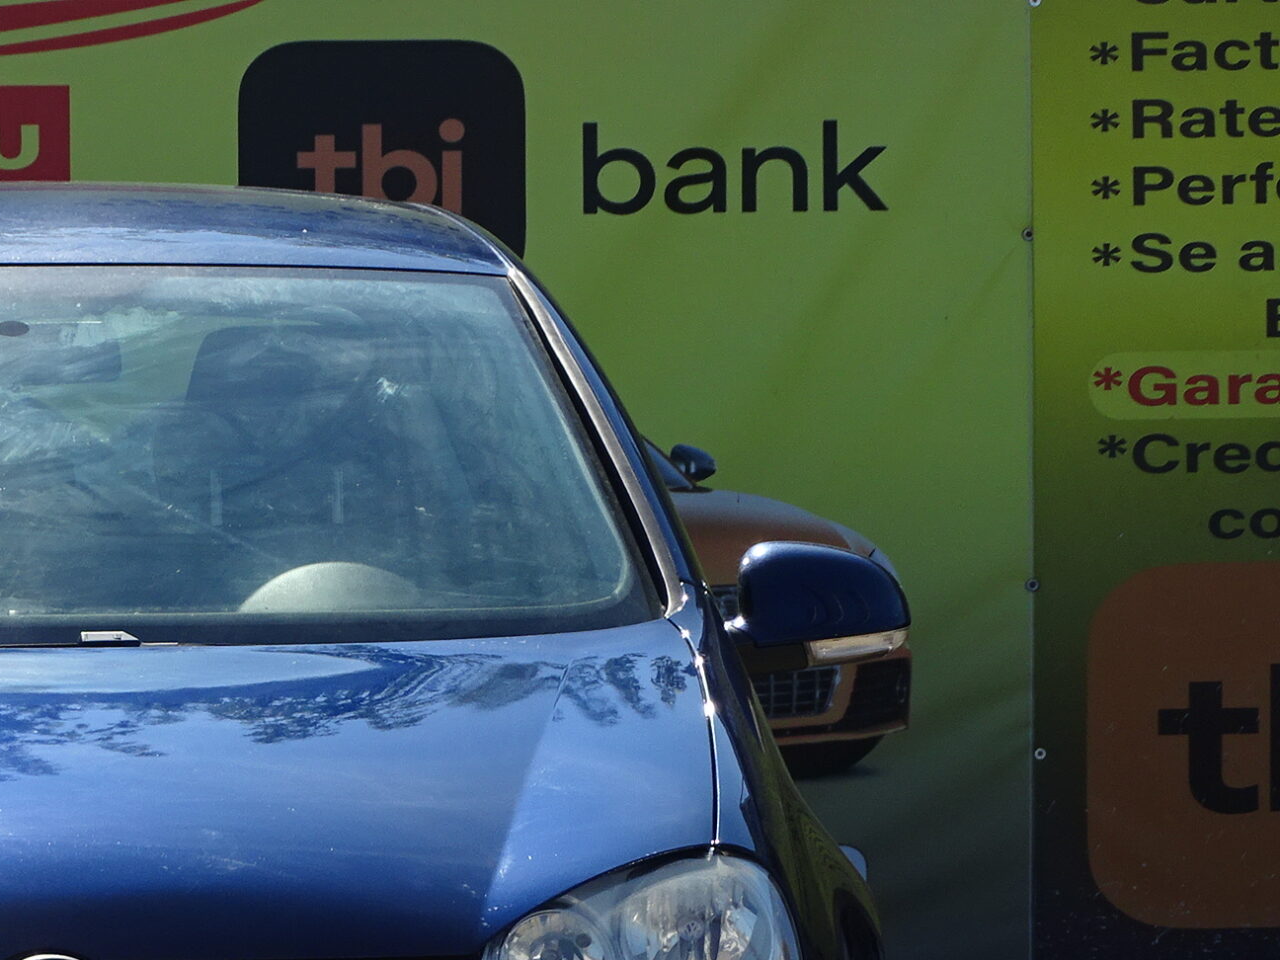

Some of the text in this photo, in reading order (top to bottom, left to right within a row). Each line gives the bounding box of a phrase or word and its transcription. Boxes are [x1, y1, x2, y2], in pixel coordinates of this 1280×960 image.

[1131, 99, 1280, 139] Rate
[297, 118, 889, 216] tbi bank
[1132, 162, 1280, 206] Perf
[1130, 233, 1217, 273] Se
[1158, 664, 1280, 815] t
